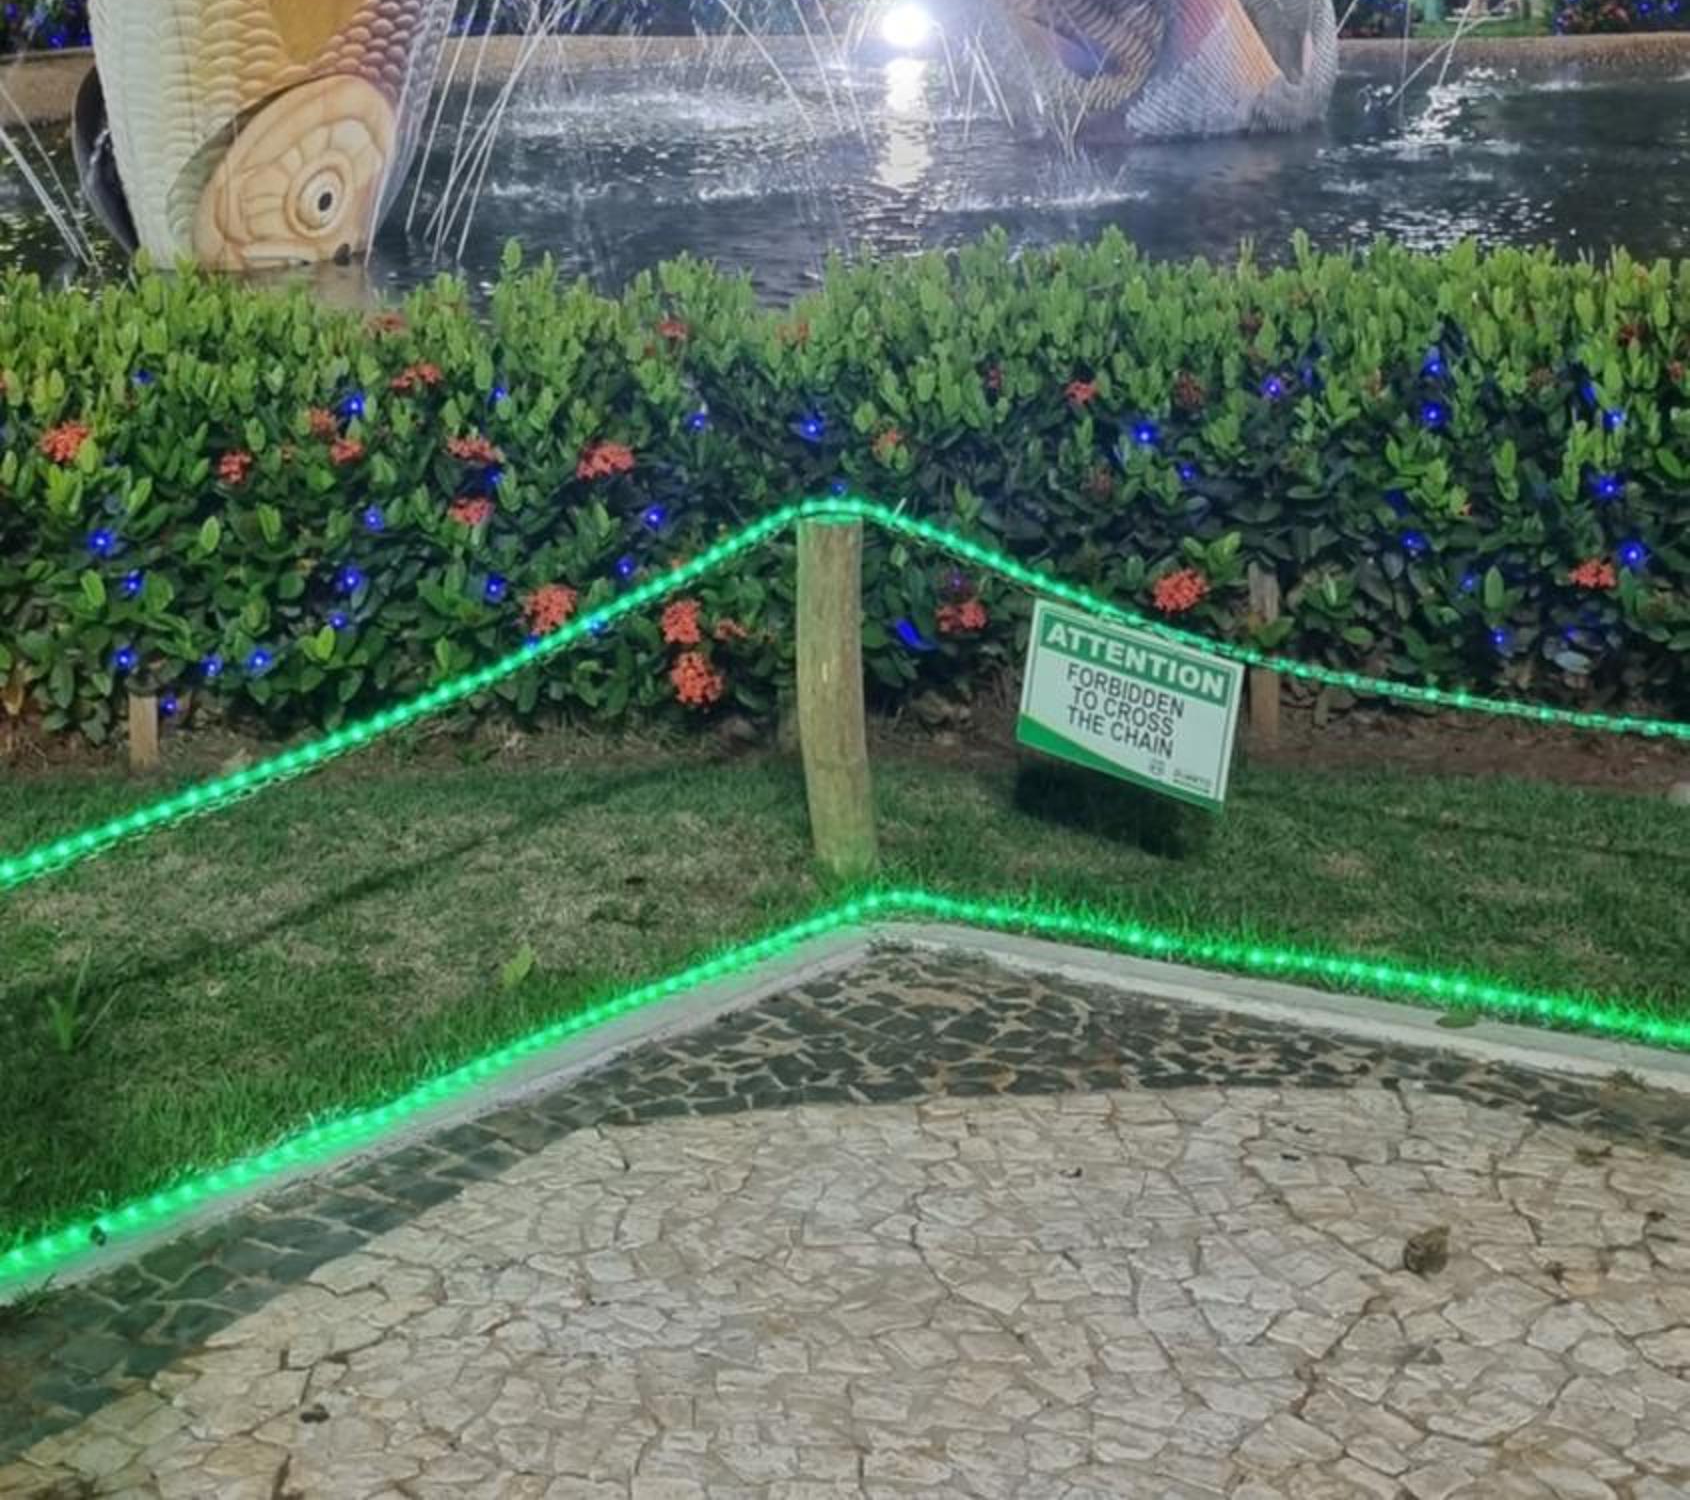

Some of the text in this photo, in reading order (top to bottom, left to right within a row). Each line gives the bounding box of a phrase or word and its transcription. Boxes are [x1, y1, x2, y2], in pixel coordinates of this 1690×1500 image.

[1046, 622, 1225, 698] ATTENTION
[1067, 663, 1184, 718] FORBIDDEN
[1073, 686, 1174, 737] TO CROSS
[1068, 706, 1174, 759] THE CHAIN
